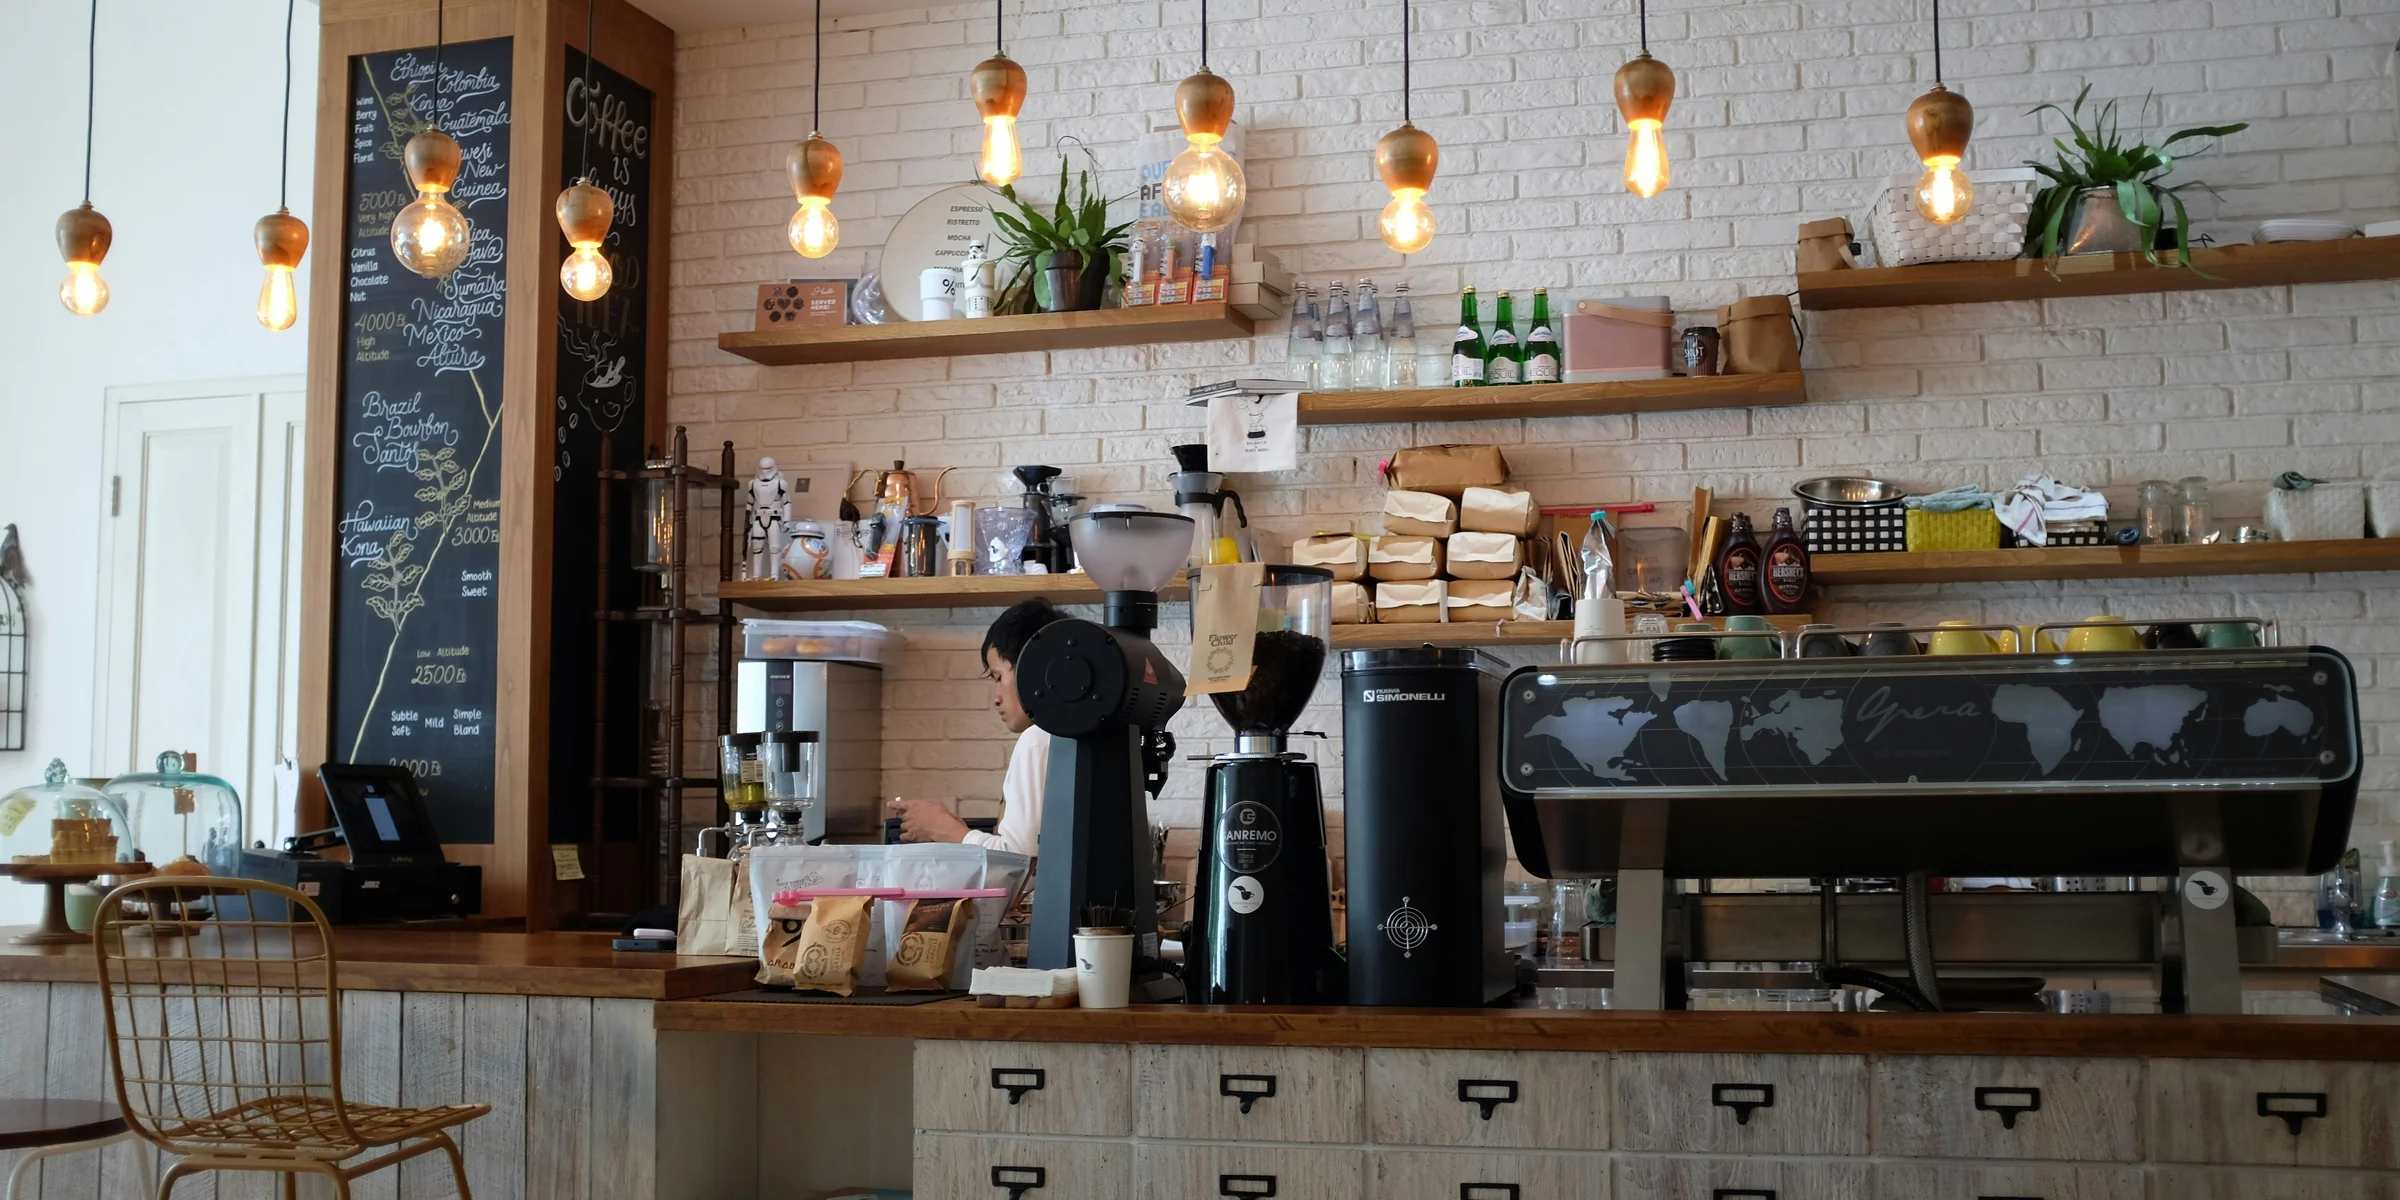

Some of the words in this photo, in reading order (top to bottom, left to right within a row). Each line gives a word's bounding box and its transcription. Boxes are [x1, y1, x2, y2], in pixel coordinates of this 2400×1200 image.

[437, 67, 500, 103] Colombia
[356, 110, 377, 121] Berry
[438, 101, 512, 136] Guatemala
[354, 123, 374, 133] Fruit
[353, 138, 373, 149] Spice
[353, 153, 374, 163] Floral
[464, 161, 505, 179] New
[612, 151, 630, 185] is
[451, 178, 506, 208] Guinea
[359, 190, 396, 212] 5000
[358, 225, 390, 237] Altitude
[351, 248, 376, 258] Citrus
[351, 261, 378, 273] Vanilla
[350, 275, 388, 287] Chocolate
[445, 268, 507, 303] Sumatra
[350, 292, 366, 302] Nut
[412, 298, 503, 327] Nicaragua
[354, 312, 395, 332] 4000
[403, 324, 482, 346] Mexico
[357, 336, 376, 349] High
[356, 350, 390, 362] Altitude
[417, 343, 485, 377] Altura
[1529, 369, 1556, 377] EQUIL
[362, 391, 421, 421] Brazil
[384, 413, 458, 446] Bourbon
[353, 426, 419, 473] Santos
[473, 500, 500, 509] Medium
[338, 500, 418, 541] Hawaiian
[466, 513, 498, 523] Altitude
[451, 526, 490, 546] 3000
[341, 535, 384, 568] Kona
[461, 570, 492, 581] Smooth
[461, 585, 487, 597] Sweet
[417, 649, 430, 658] Low
[437, 645, 470, 657] Altitude
[411, 664, 455, 685] 2500
[1376, 693, 1445, 702] SIMONELLI
[391, 710, 419, 721] Subtle
[453, 708, 482, 722] Simple
[1856, 686, 1981, 743] Opera
[425, 717, 444, 728] Mild
[391, 725, 411, 736] Soft
[453, 725, 480, 736] Bland
